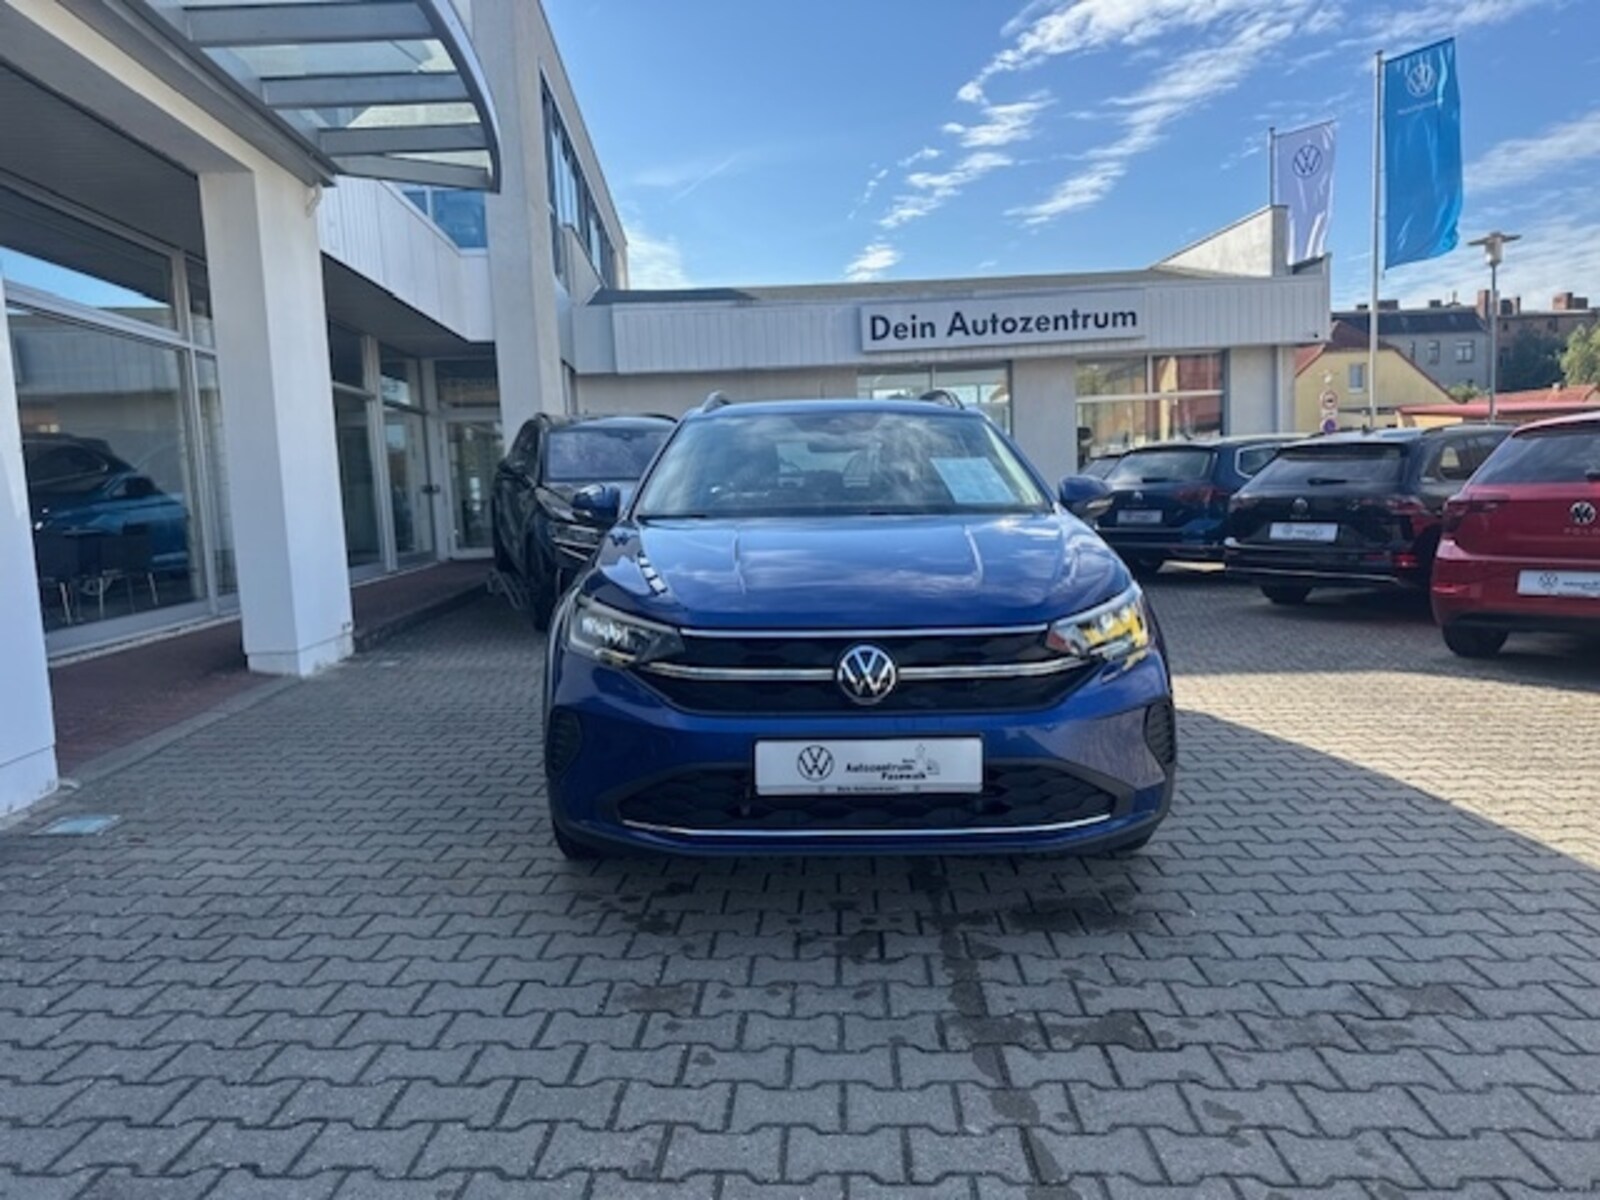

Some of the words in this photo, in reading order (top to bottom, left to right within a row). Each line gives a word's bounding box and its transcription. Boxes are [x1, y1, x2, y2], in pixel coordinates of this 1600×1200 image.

[870, 313, 936, 341] Dein
[947, 308, 1137, 337] Autozentrum
[837, 643, 896, 705] VW
